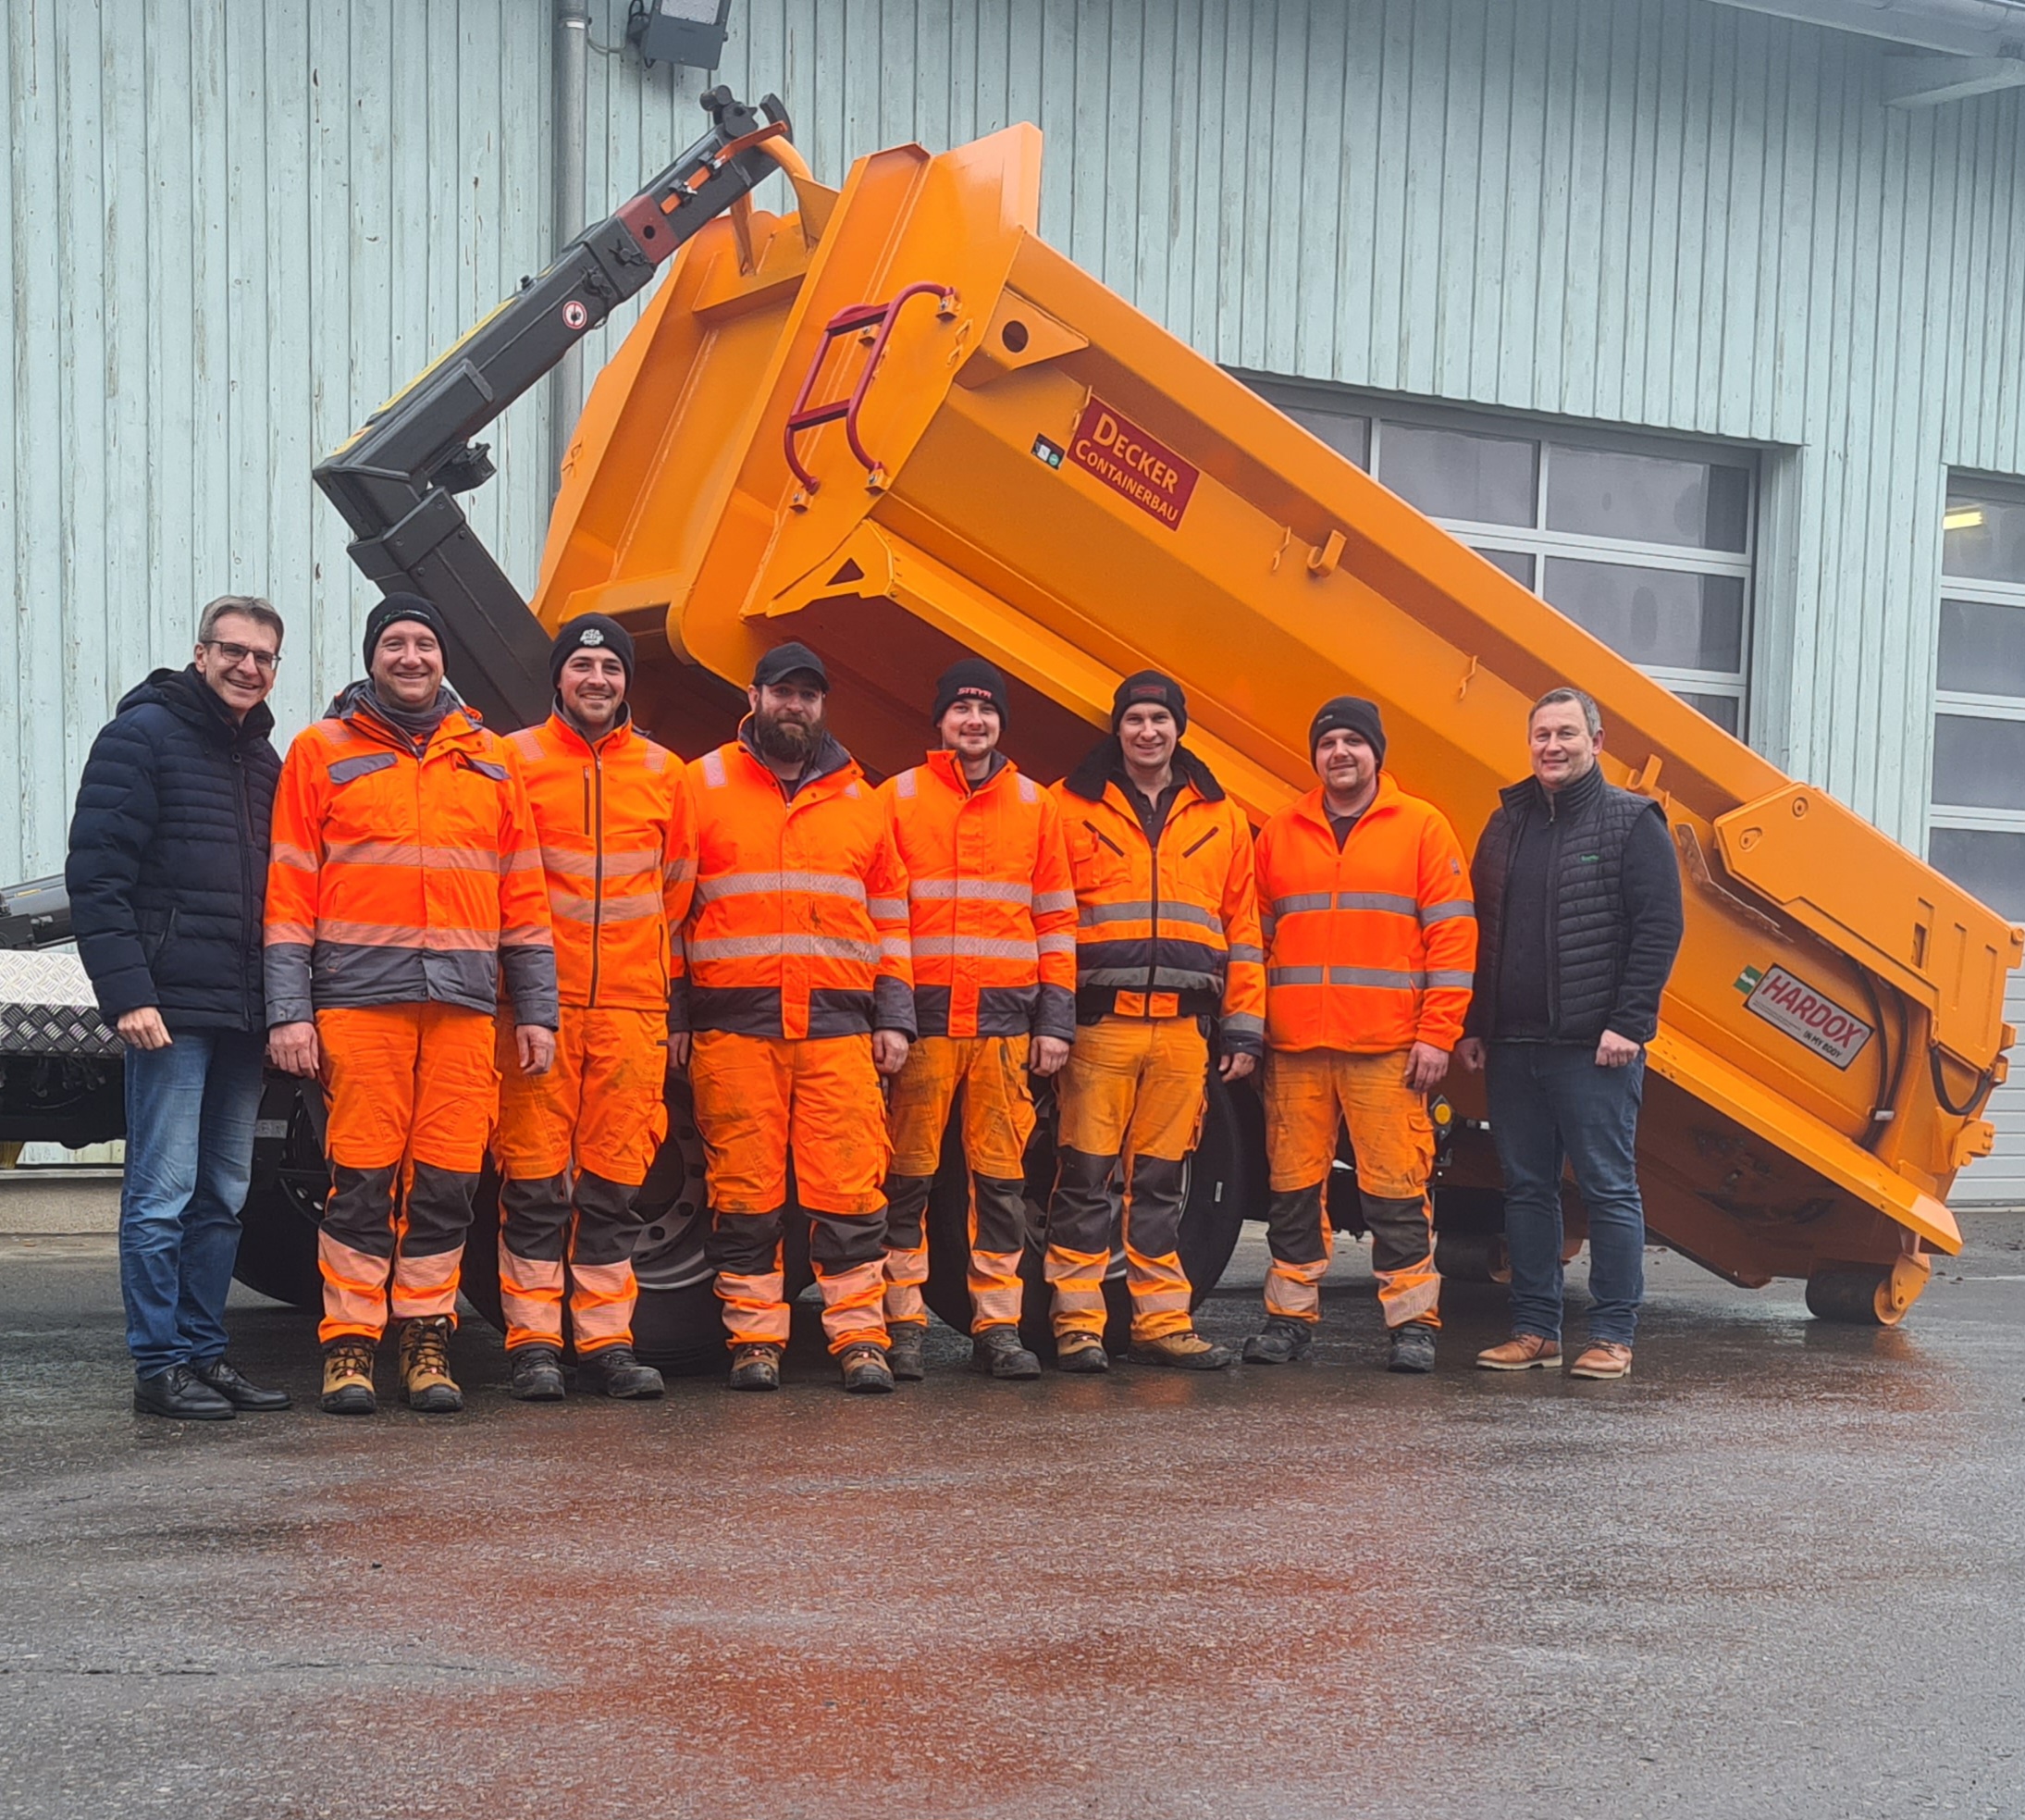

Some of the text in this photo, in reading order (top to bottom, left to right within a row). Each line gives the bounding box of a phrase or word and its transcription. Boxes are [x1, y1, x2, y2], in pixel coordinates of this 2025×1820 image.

[1075, 440, 1179, 522] CONTAINERBAU
[1093, 413, 1179, 494] DECKER
[1760, 974, 1862, 1048] HARDOX
[1803, 1030, 1843, 1059] IN MY BODY
